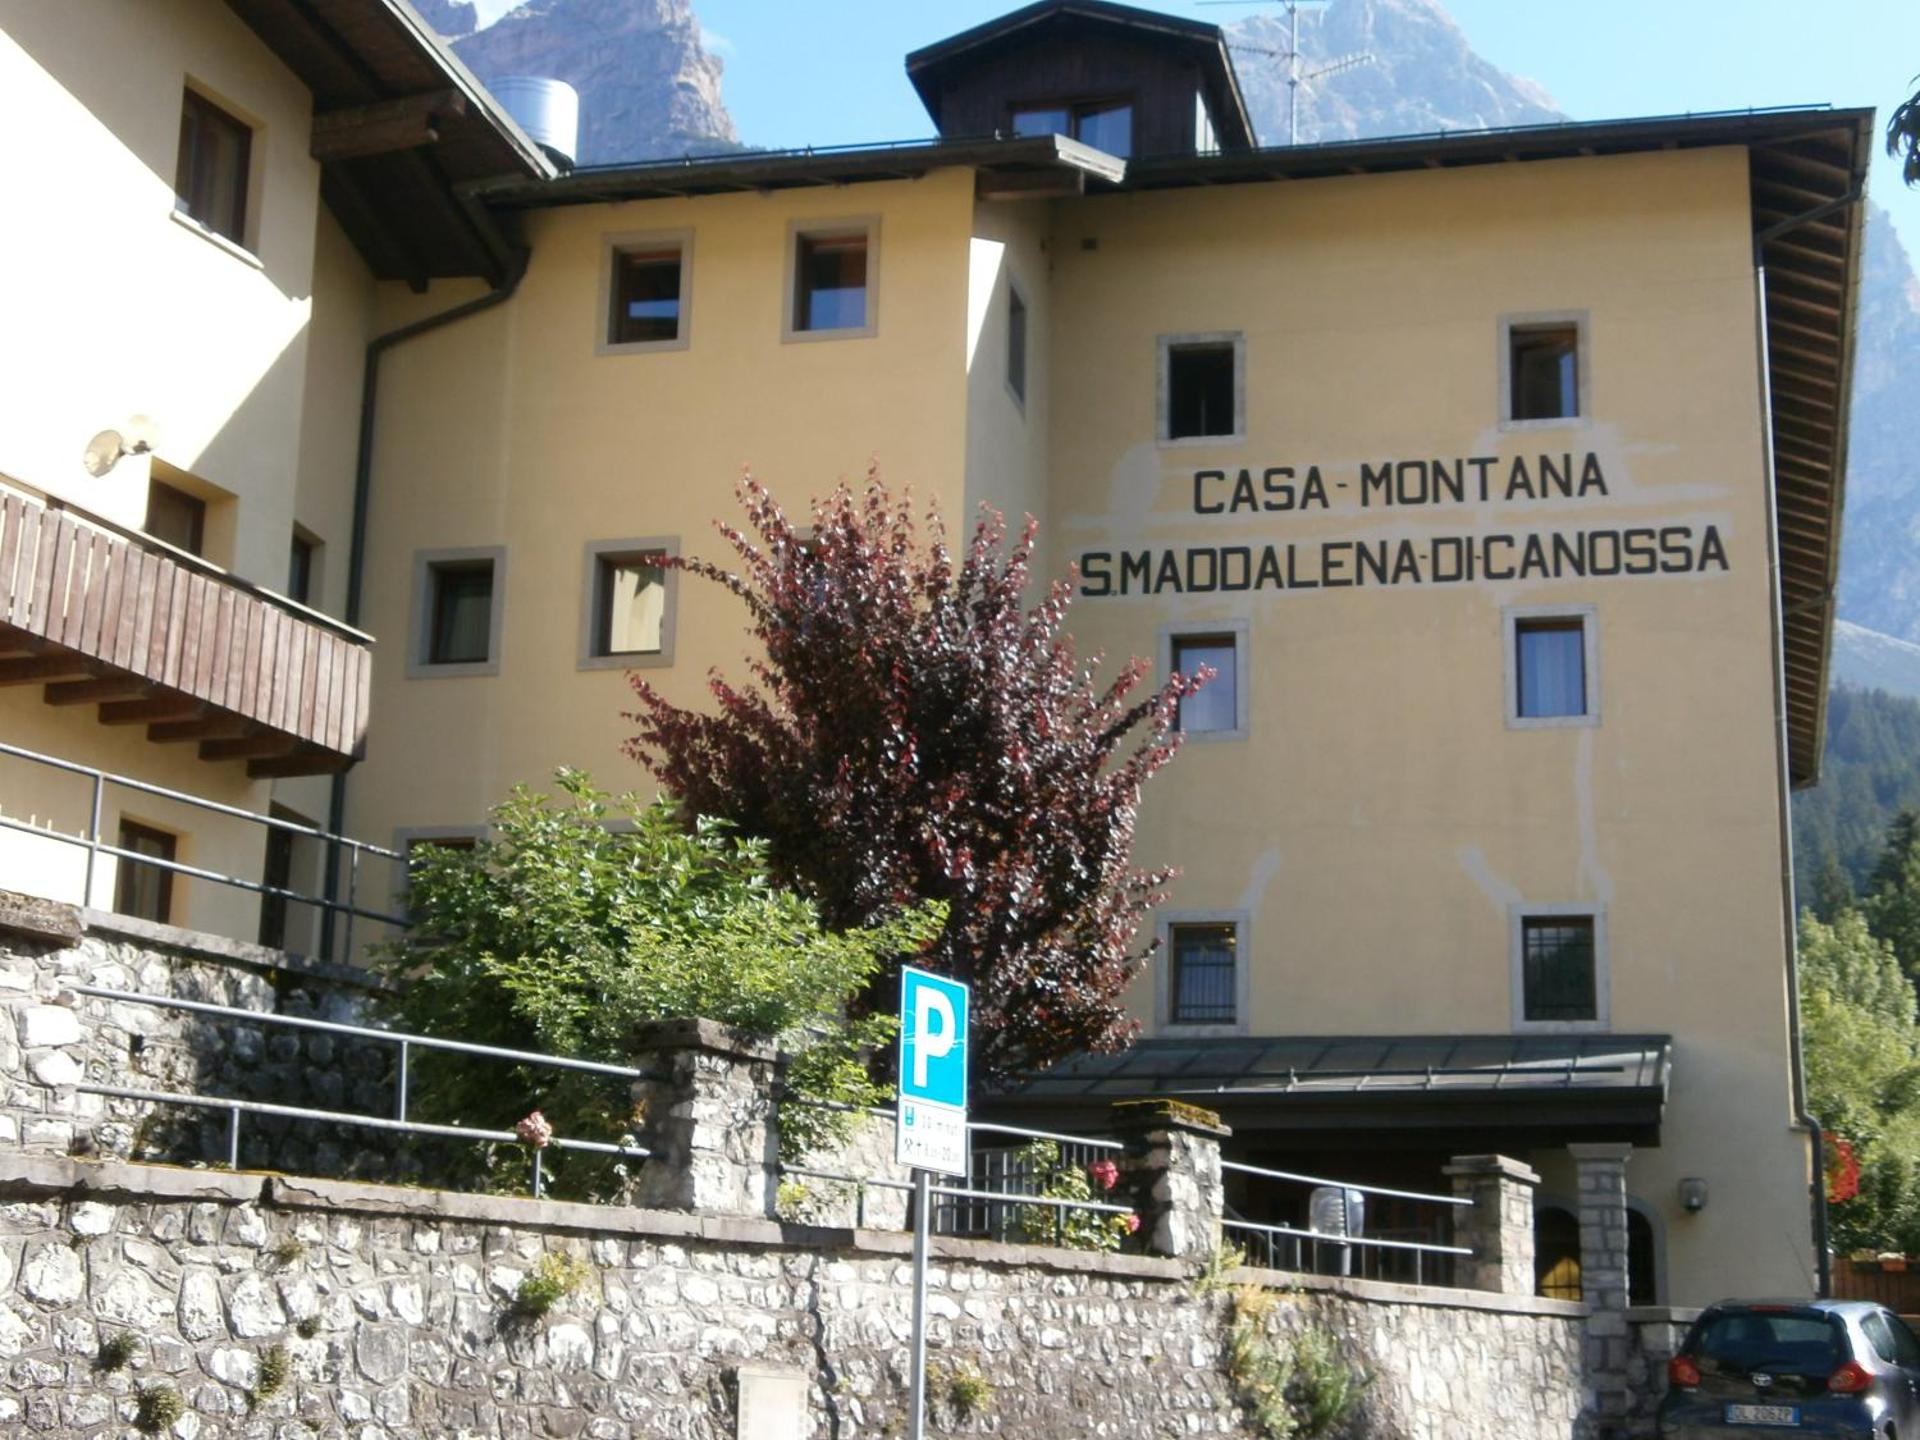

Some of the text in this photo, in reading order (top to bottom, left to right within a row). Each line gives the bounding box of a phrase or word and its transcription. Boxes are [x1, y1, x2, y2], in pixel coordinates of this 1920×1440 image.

[1193, 466, 1330, 515] CASA
[1360, 452, 1609, 507] MONTANA
[913, 983, 956, 1089] P
